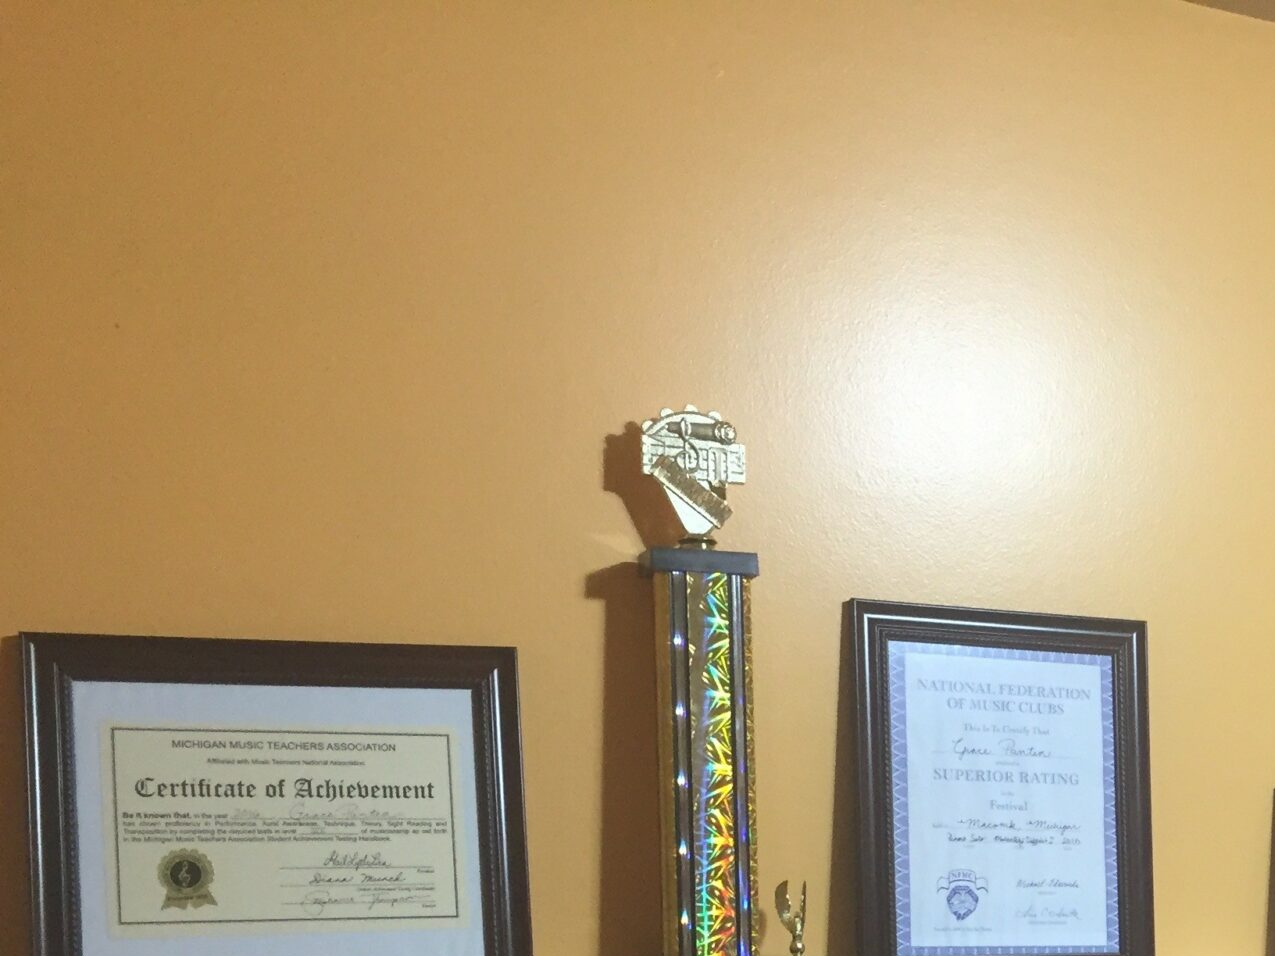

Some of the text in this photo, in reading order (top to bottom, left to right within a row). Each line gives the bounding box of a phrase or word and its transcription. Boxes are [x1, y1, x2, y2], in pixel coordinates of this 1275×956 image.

[917, 678, 1092, 700] NATIONAL FEDERATION
[946, 697, 1065, 715] OF MUSIC CLUBS
[172, 738, 397, 753] MICHIGAN MUSIC TEACHERS ASSOCIATION
[933, 767, 1080, 786] SUPERIOR RATING
[134, 777, 435, 802] Certificate of Achievement
[989, 799, 1028, 812] Festival
[122, 811, 134, 819] Be
[144, 811, 172, 819] known
